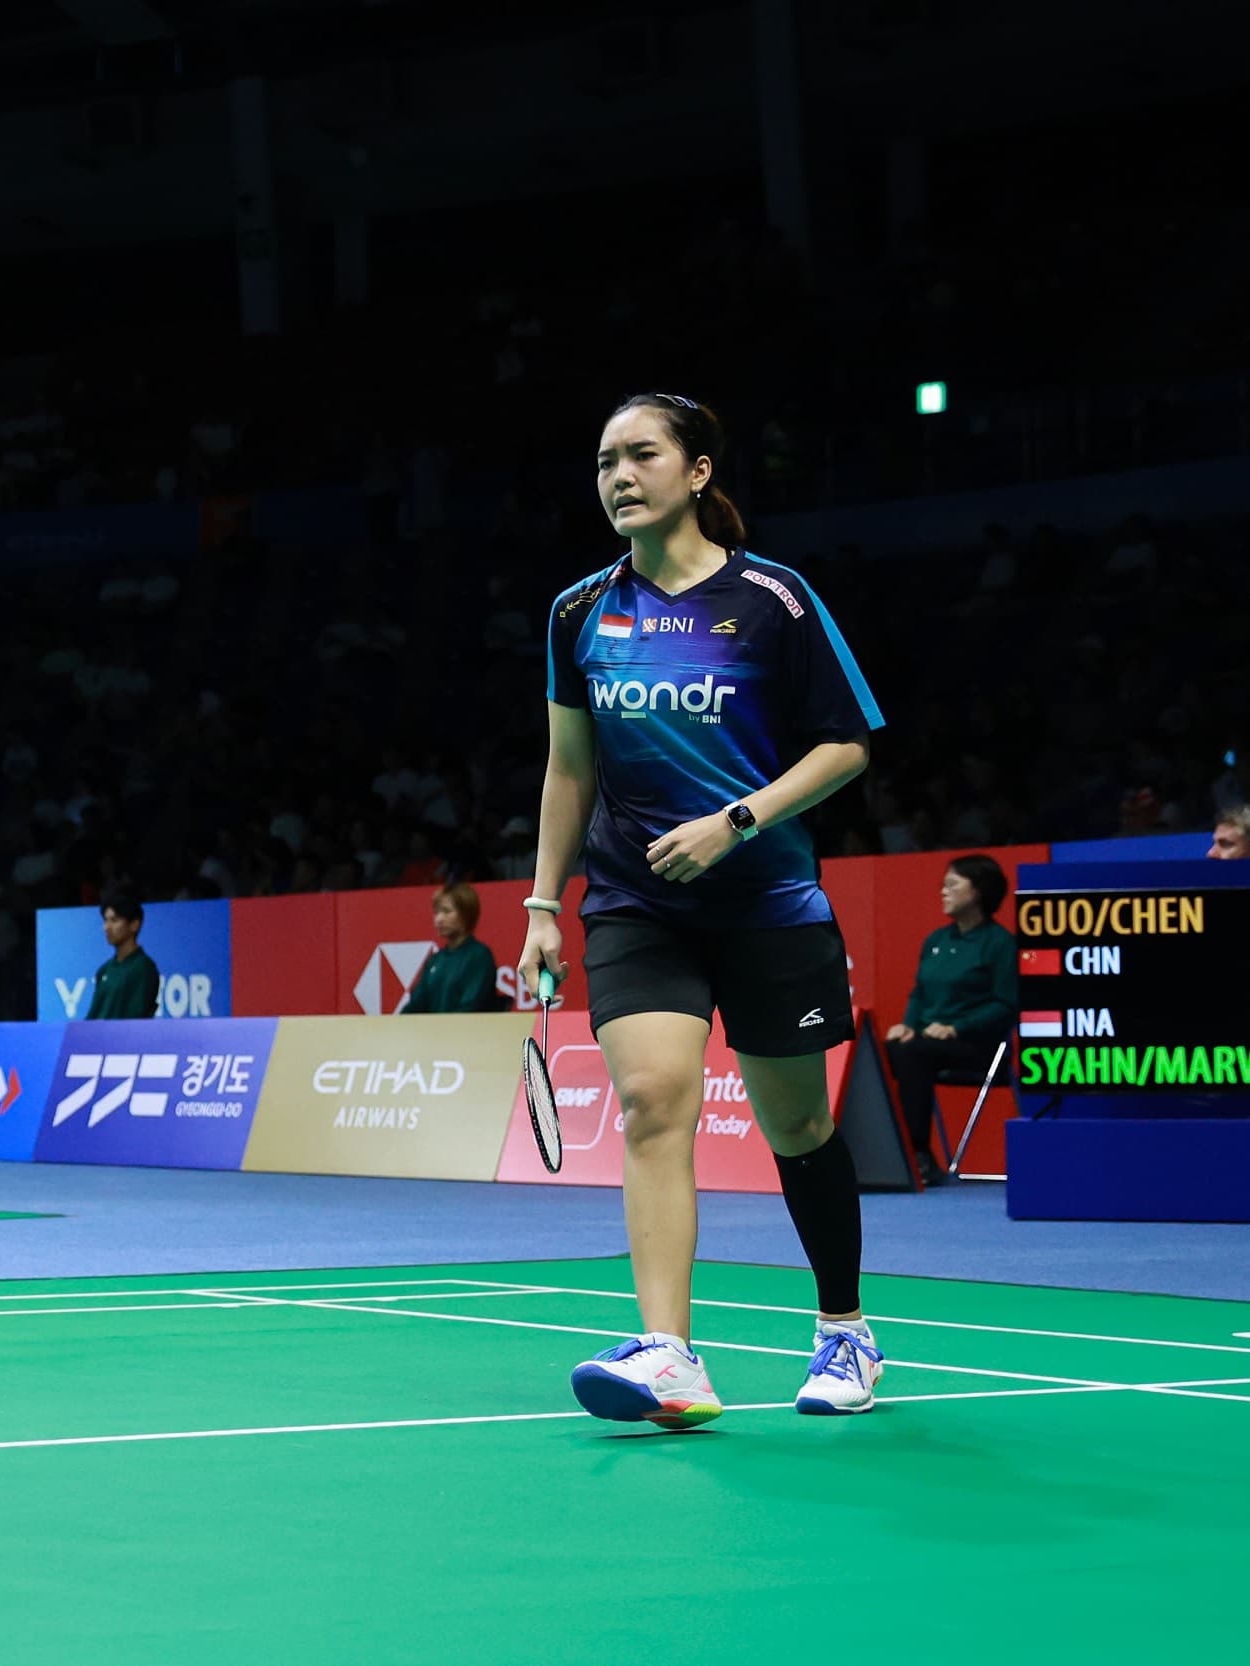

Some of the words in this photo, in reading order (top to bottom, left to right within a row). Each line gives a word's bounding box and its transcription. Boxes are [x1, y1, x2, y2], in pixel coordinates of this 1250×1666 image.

[659, 616, 694, 633] BNI
[593, 674, 736, 715] wondr
[688, 713, 700, 723] by
[702, 714, 721, 724] BNI
[1018, 895, 1205, 937] GUO/CHEN
[1064, 945, 1121, 975] CHN
[1066, 1008, 1115, 1037] INA
[182, 1054, 253, 1097] 경기도
[313, 1060, 465, 1095] ETIHAD
[333, 1106, 421, 1130] AIRWAYS
[705, 1113, 752, 1139] Today
